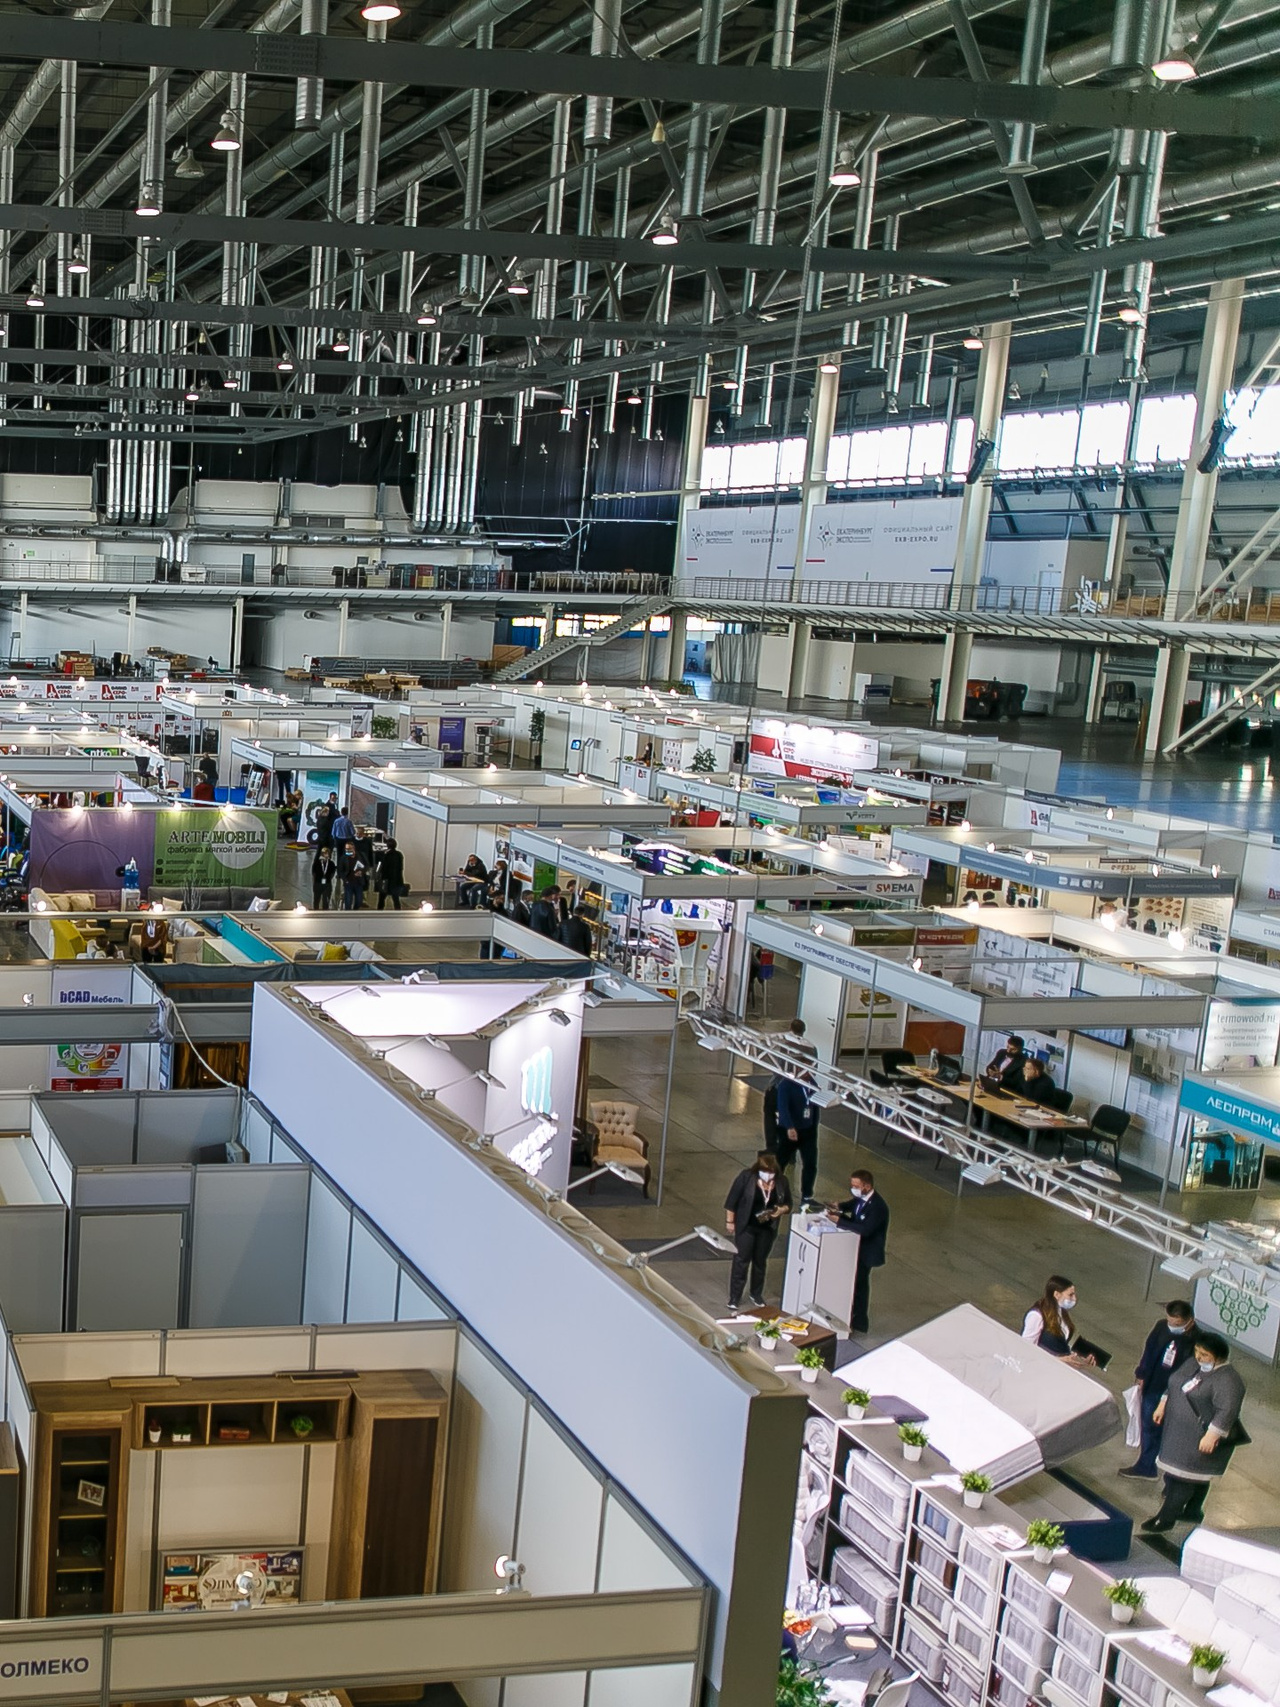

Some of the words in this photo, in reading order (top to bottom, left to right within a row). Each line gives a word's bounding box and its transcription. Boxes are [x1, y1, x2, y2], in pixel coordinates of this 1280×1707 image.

[167, 846, 203, 854] фабрика
[801, 943, 835, 962] ПРОГРАММНОЕ
[835, 956, 871, 976] ОБЕСПЕЧЕНИЕ
[60, 990, 90, 1003] bCAD
[0, 1657, 90, 1678] ОЛМЕКО
